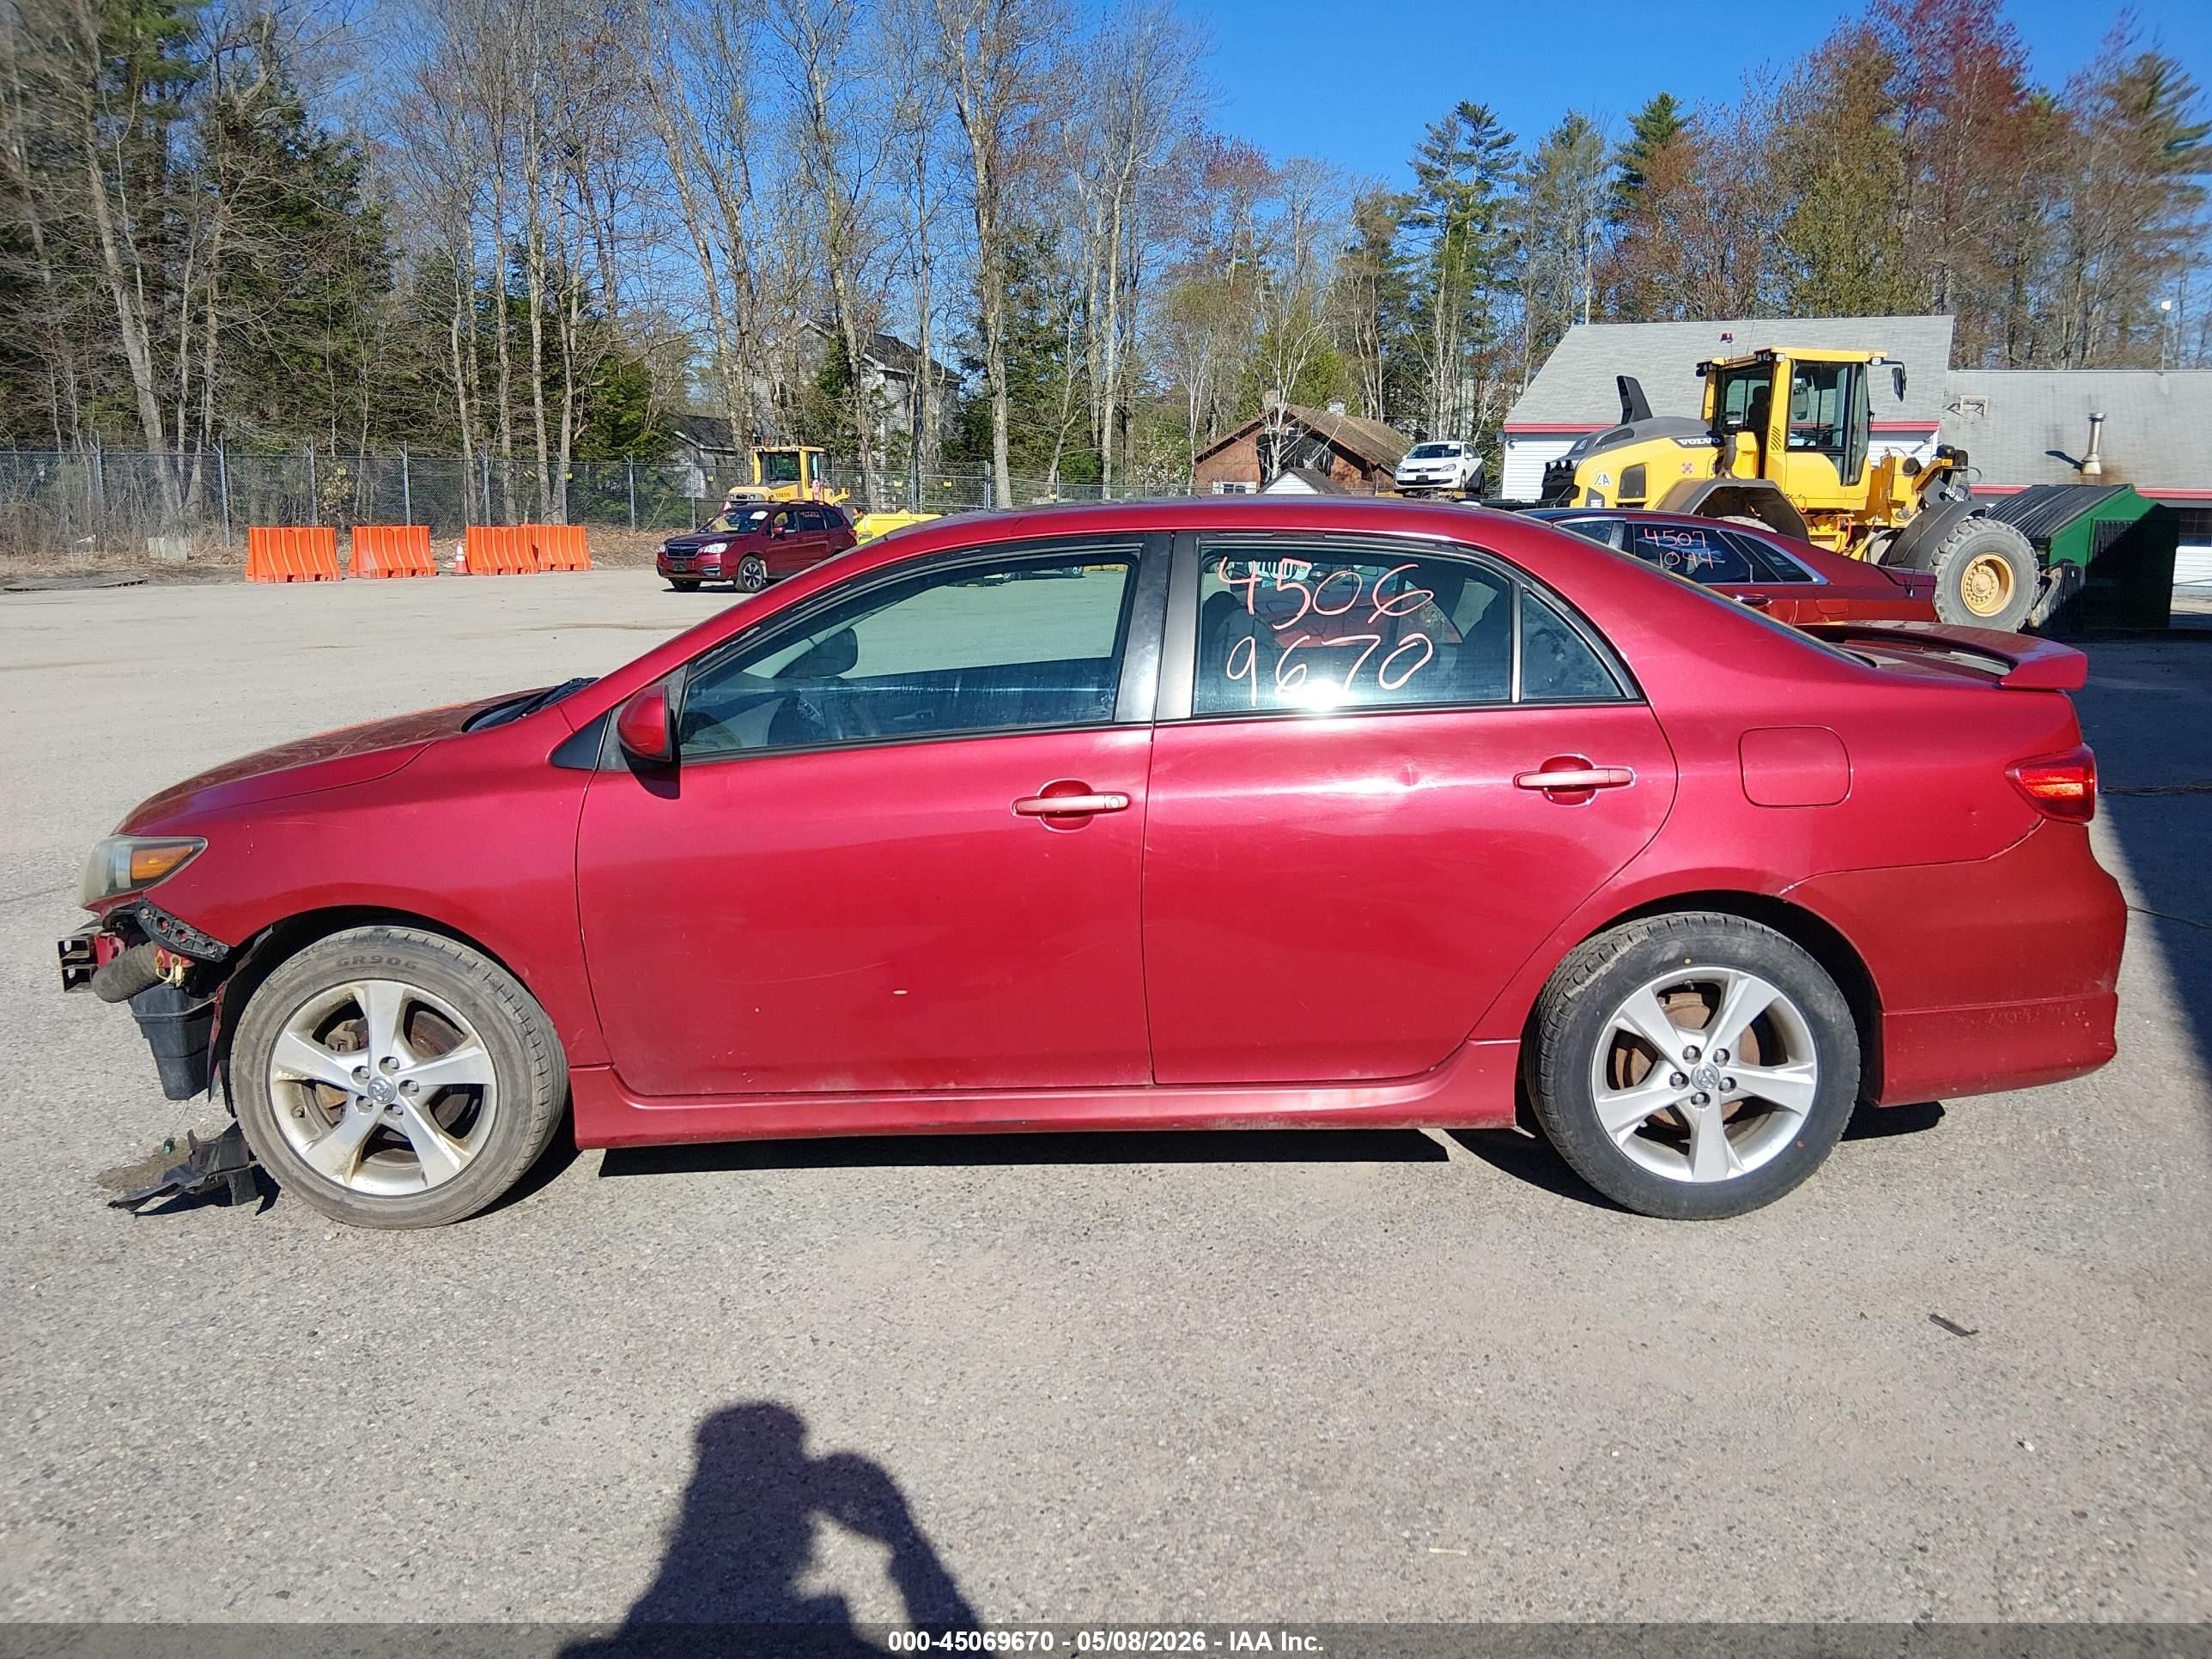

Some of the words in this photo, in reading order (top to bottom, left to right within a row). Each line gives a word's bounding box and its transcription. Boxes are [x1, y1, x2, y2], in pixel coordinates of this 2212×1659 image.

[1945, 487, 1955, 498] DO
[1644, 528, 1705, 548] 4507
[1659, 550, 1713, 569] 1044
[1218, 556, 1435, 630] 4506
[1226, 633, 1433, 707] 9670
